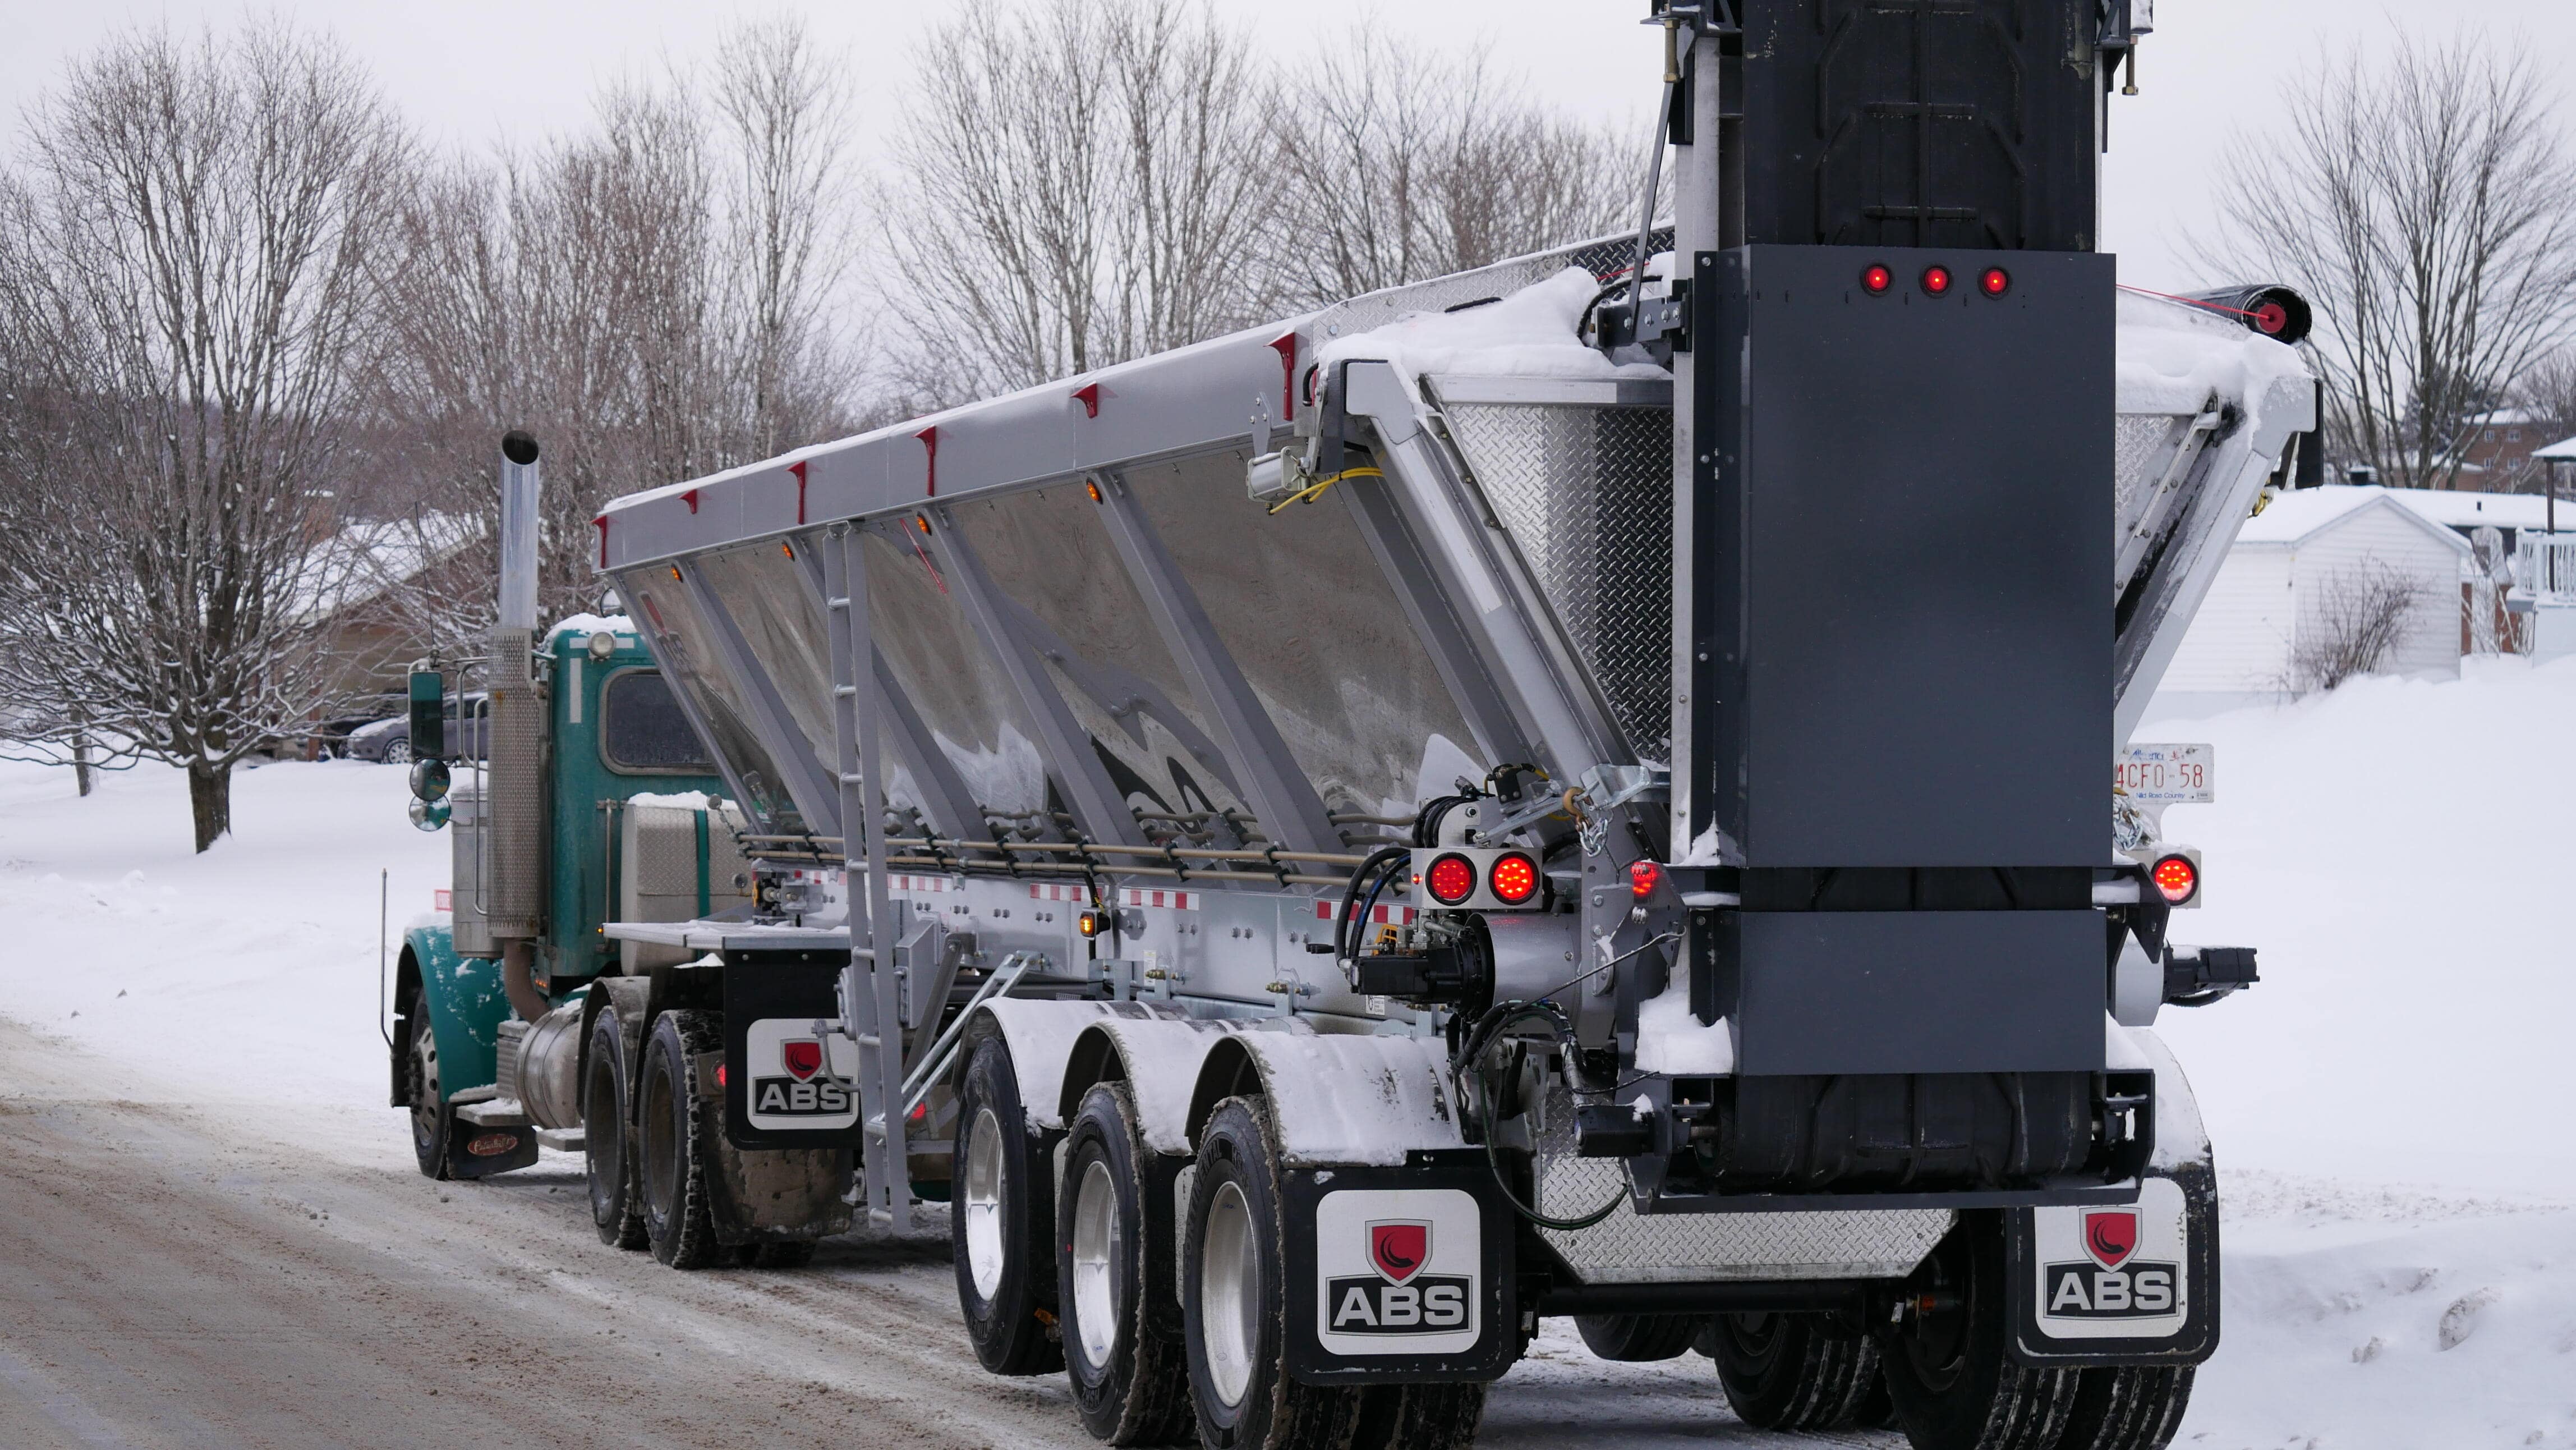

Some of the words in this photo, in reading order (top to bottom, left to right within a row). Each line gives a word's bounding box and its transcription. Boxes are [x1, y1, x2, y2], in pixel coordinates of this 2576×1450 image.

[757, 1083, 847, 1111] ABS
[1333, 1285, 1464, 1326] ABS
[2050, 1270, 2172, 1311] ABS
